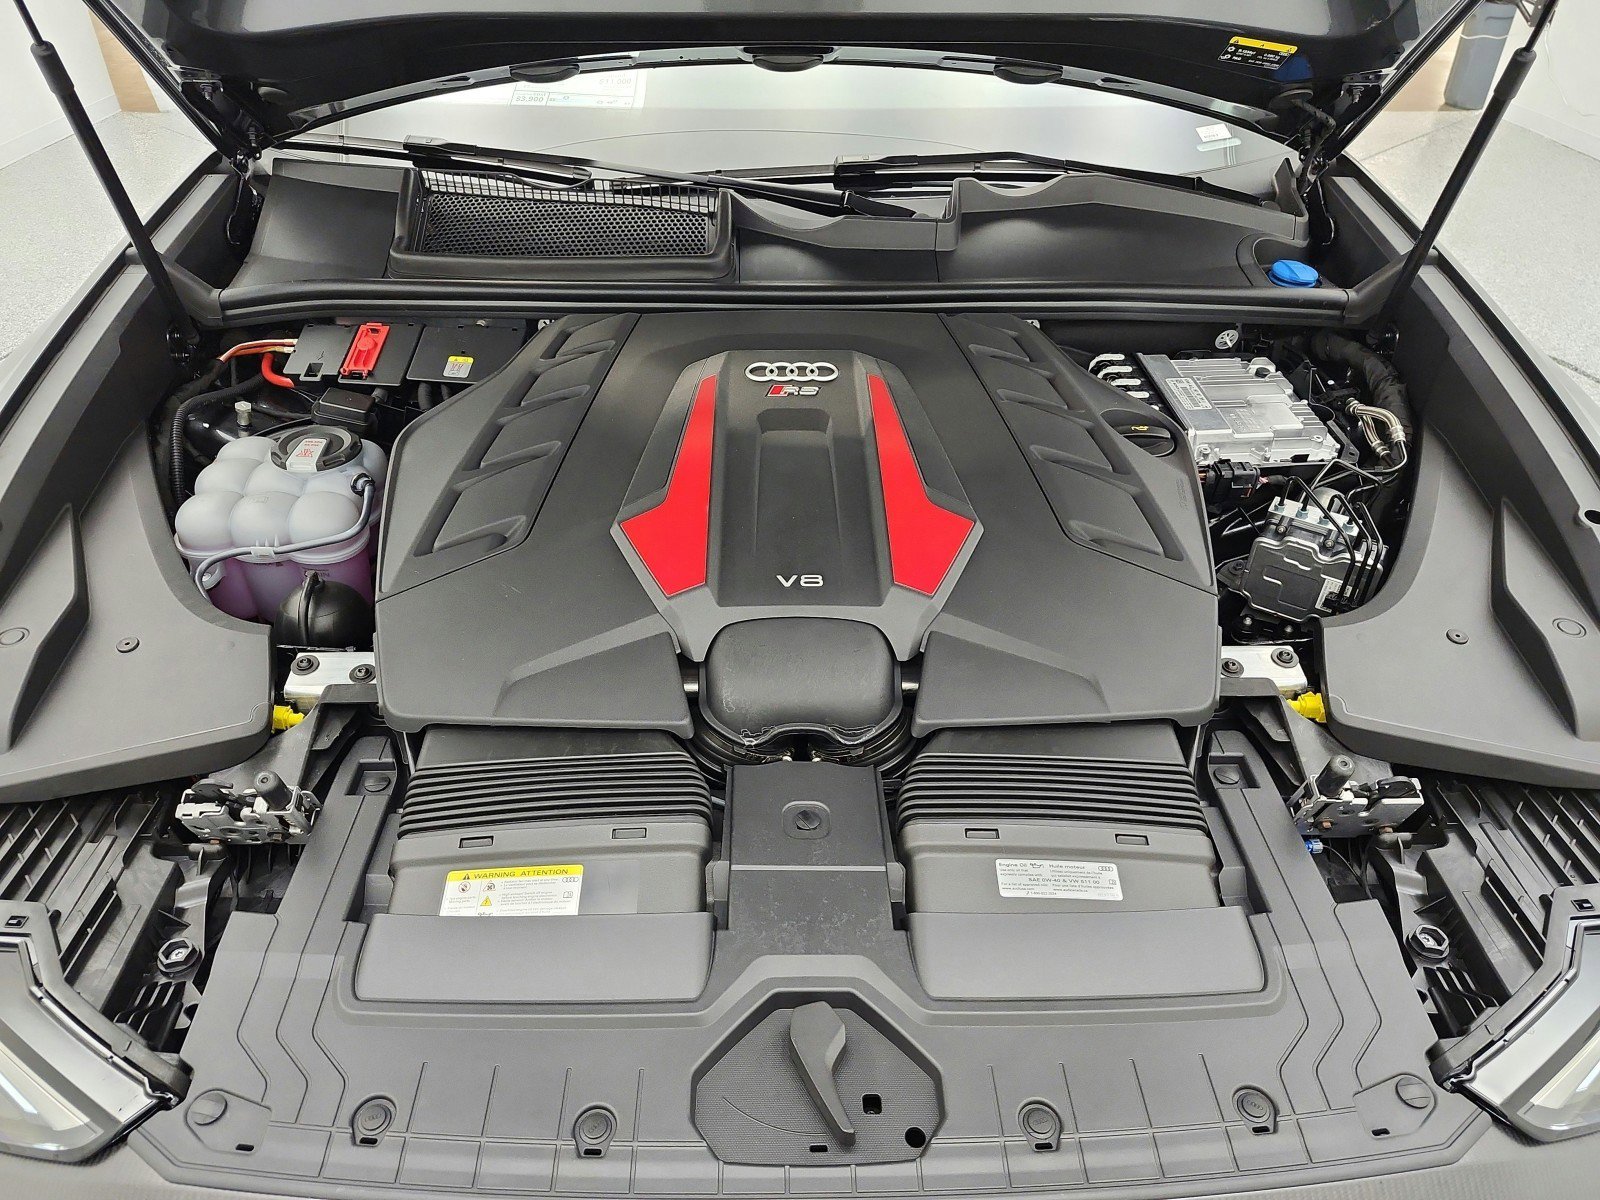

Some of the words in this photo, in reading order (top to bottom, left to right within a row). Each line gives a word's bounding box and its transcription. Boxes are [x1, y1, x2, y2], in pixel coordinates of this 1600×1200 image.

[767, 385, 819, 396] RS
[776, 575, 823, 587] V8
[474, 871, 516, 879] WARNING
